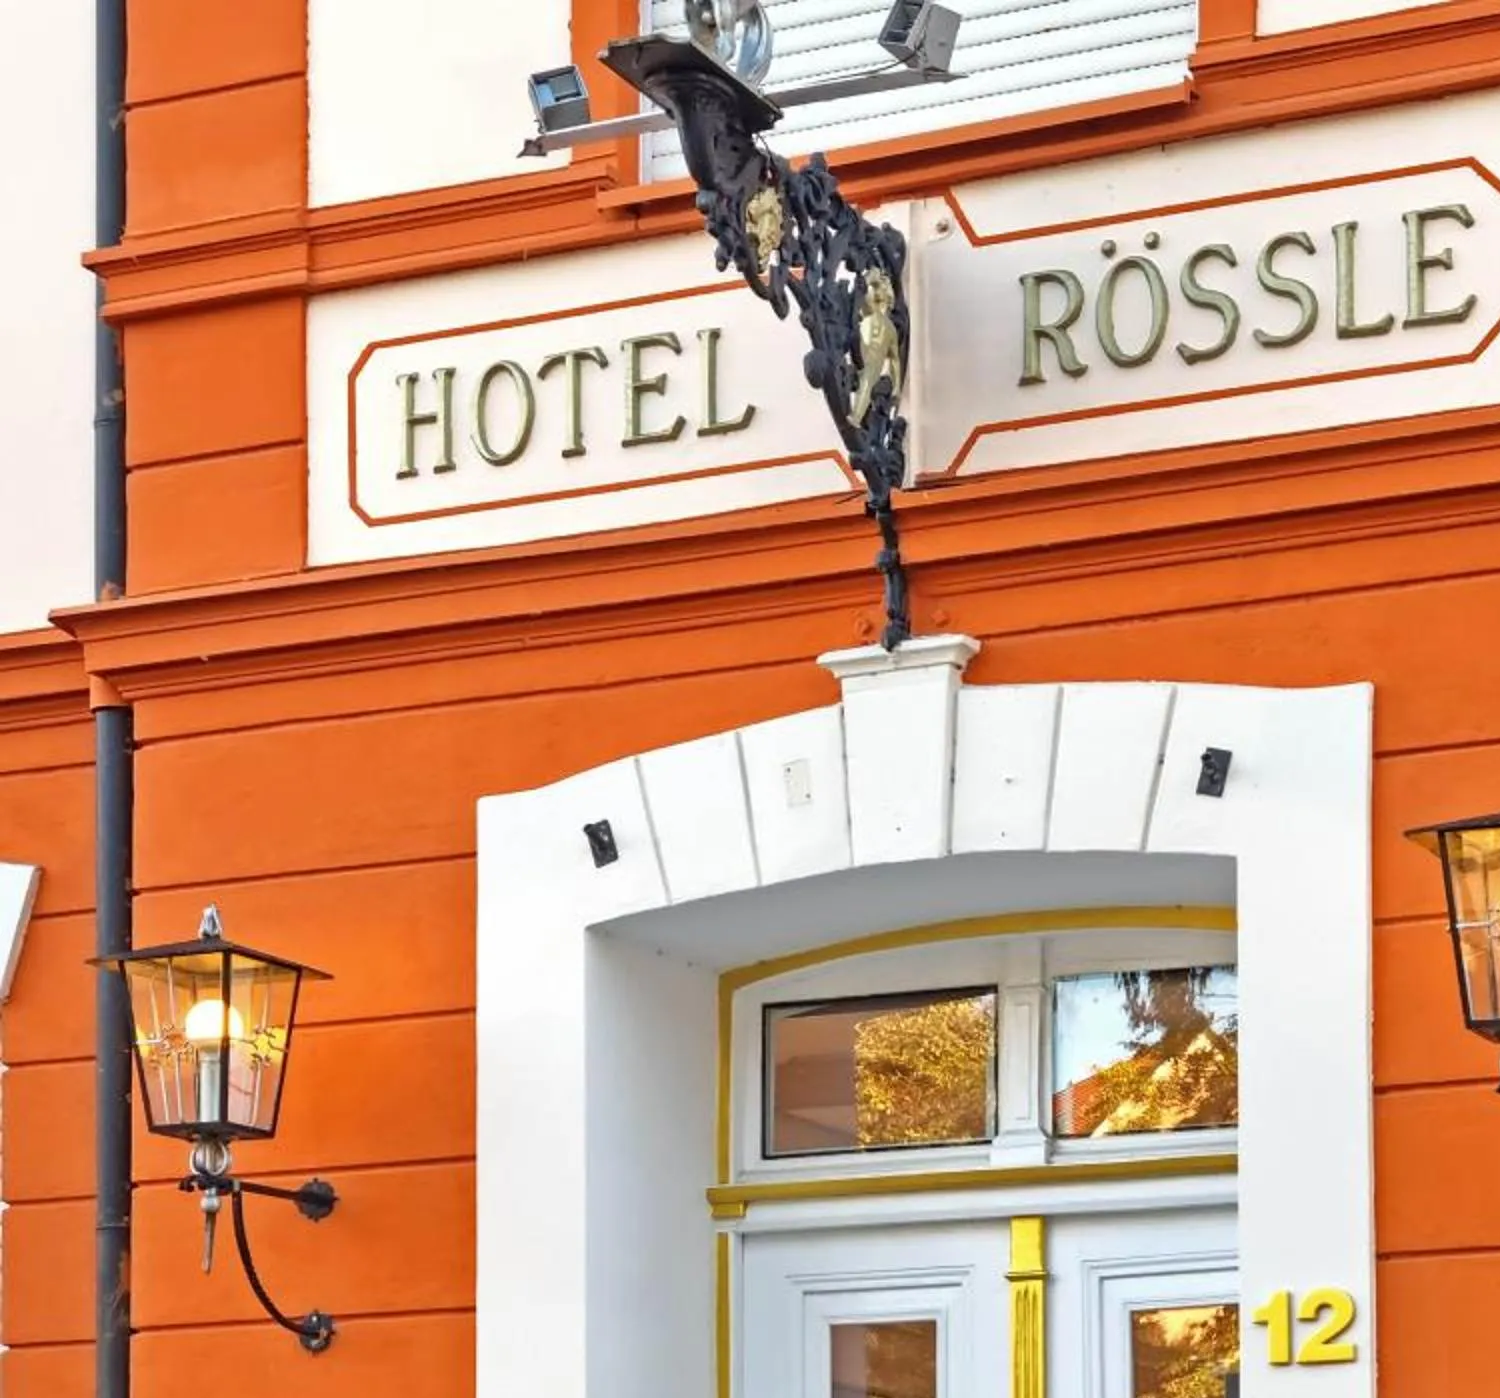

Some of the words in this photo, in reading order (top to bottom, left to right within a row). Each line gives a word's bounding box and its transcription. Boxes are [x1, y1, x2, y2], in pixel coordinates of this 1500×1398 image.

[395, 327, 757, 480] HOTEL
[1017, 203, 1479, 387] RÖSSLE
[1252, 1287, 1358, 1366] 12
